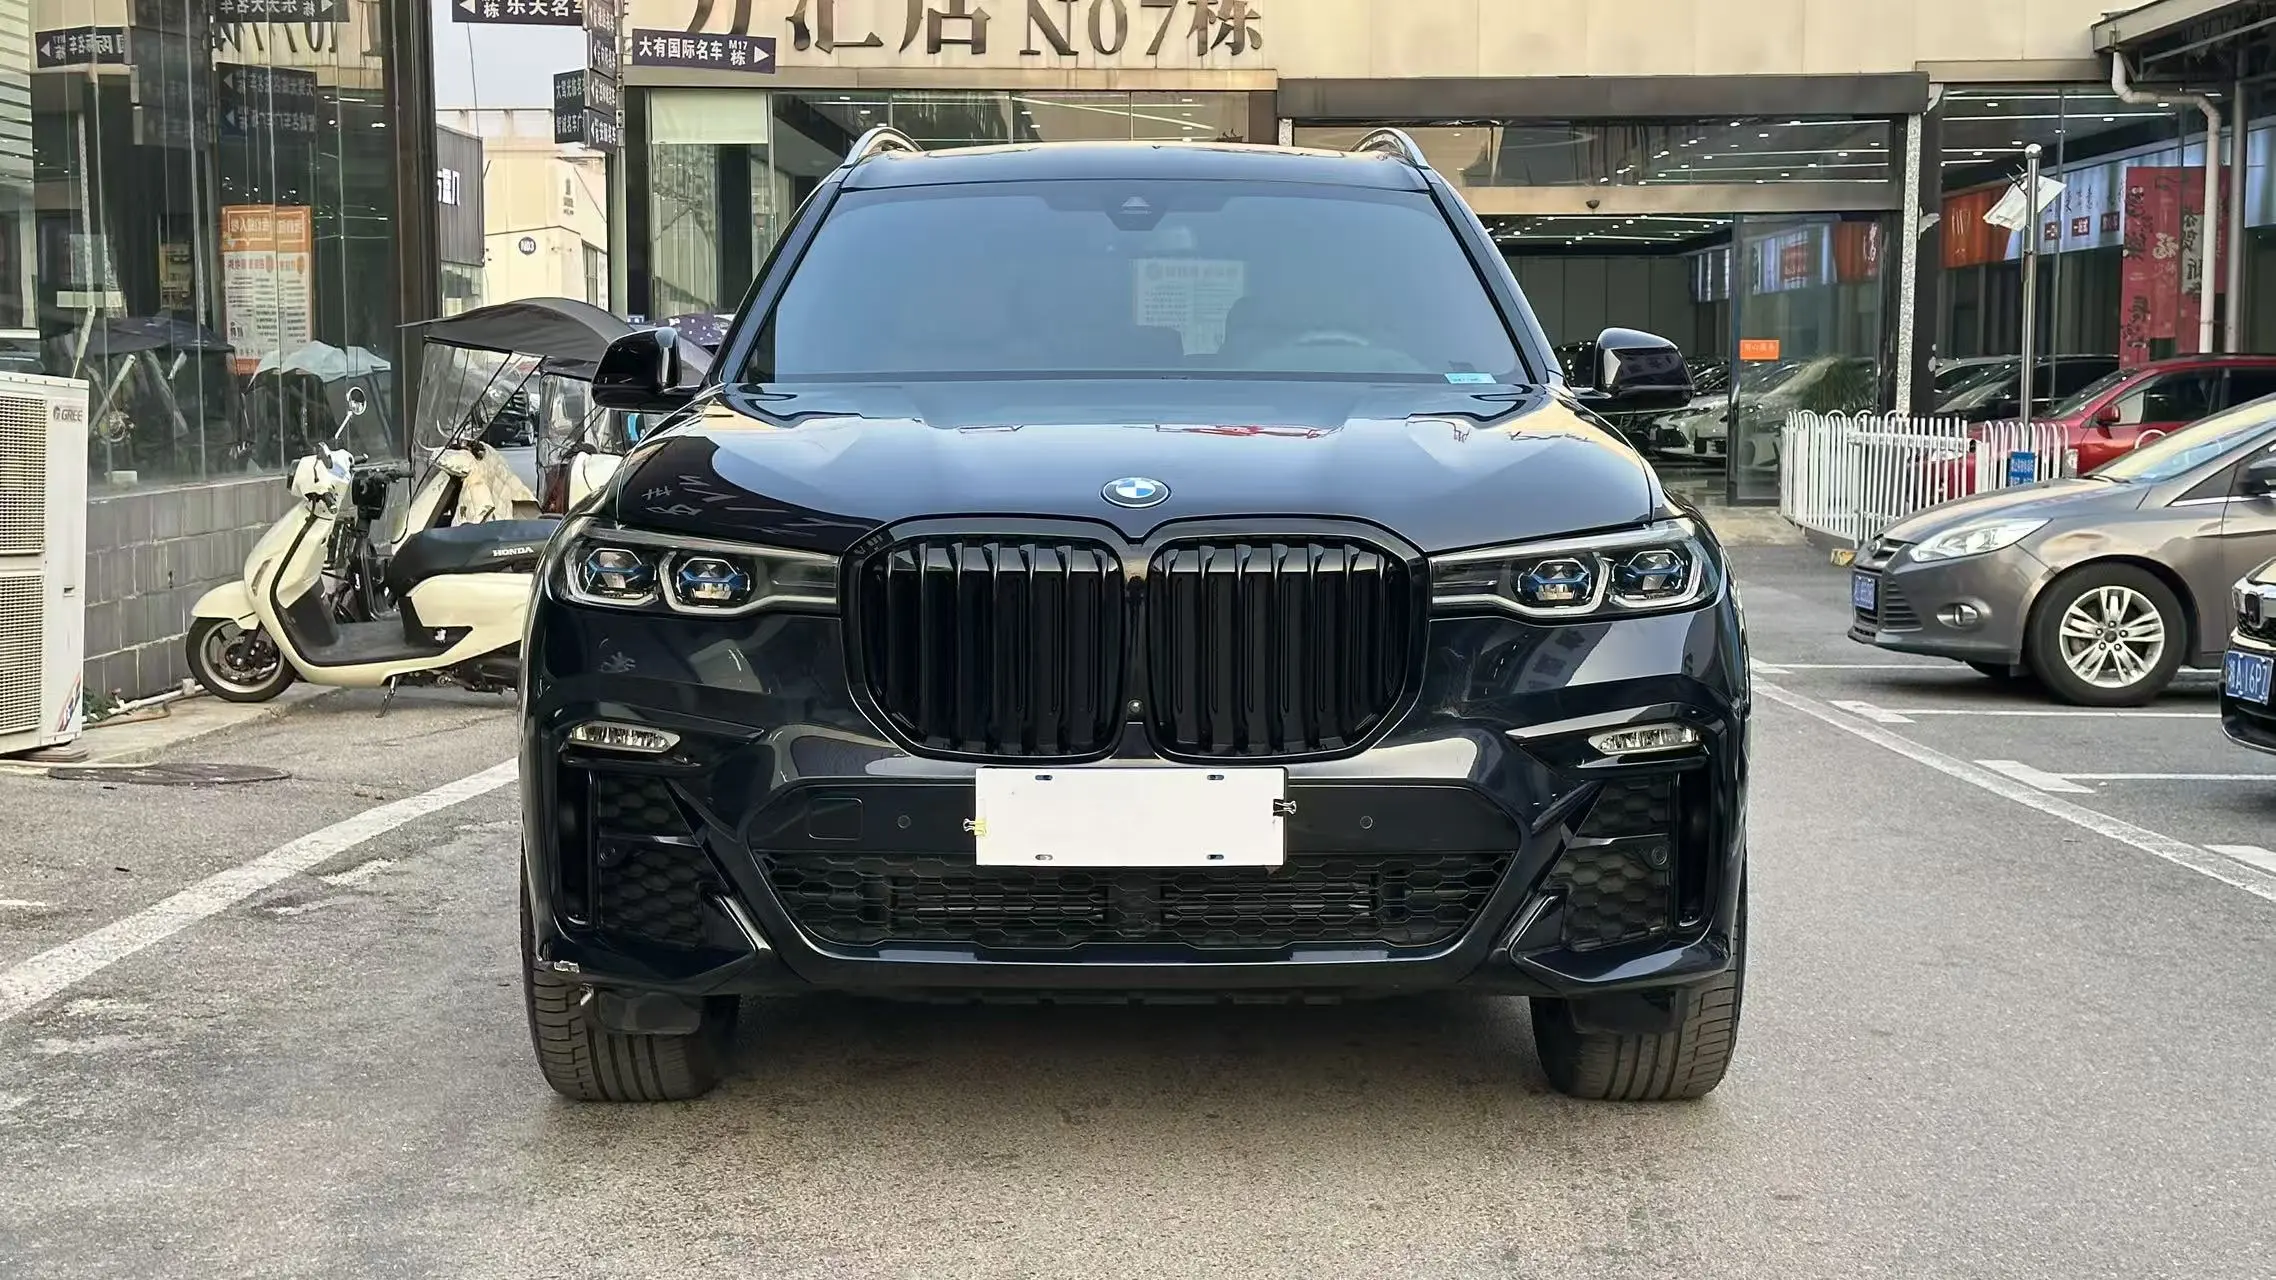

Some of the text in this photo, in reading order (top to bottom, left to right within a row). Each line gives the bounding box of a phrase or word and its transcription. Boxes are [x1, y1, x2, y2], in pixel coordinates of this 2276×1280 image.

[639, 36, 723, 61] 大有国际名车
[728, 40, 748, 50] M17
[730, 49, 746, 66] 栋
[62, 408, 83, 421] GREE
[492, 546, 534, 557] HONDA
